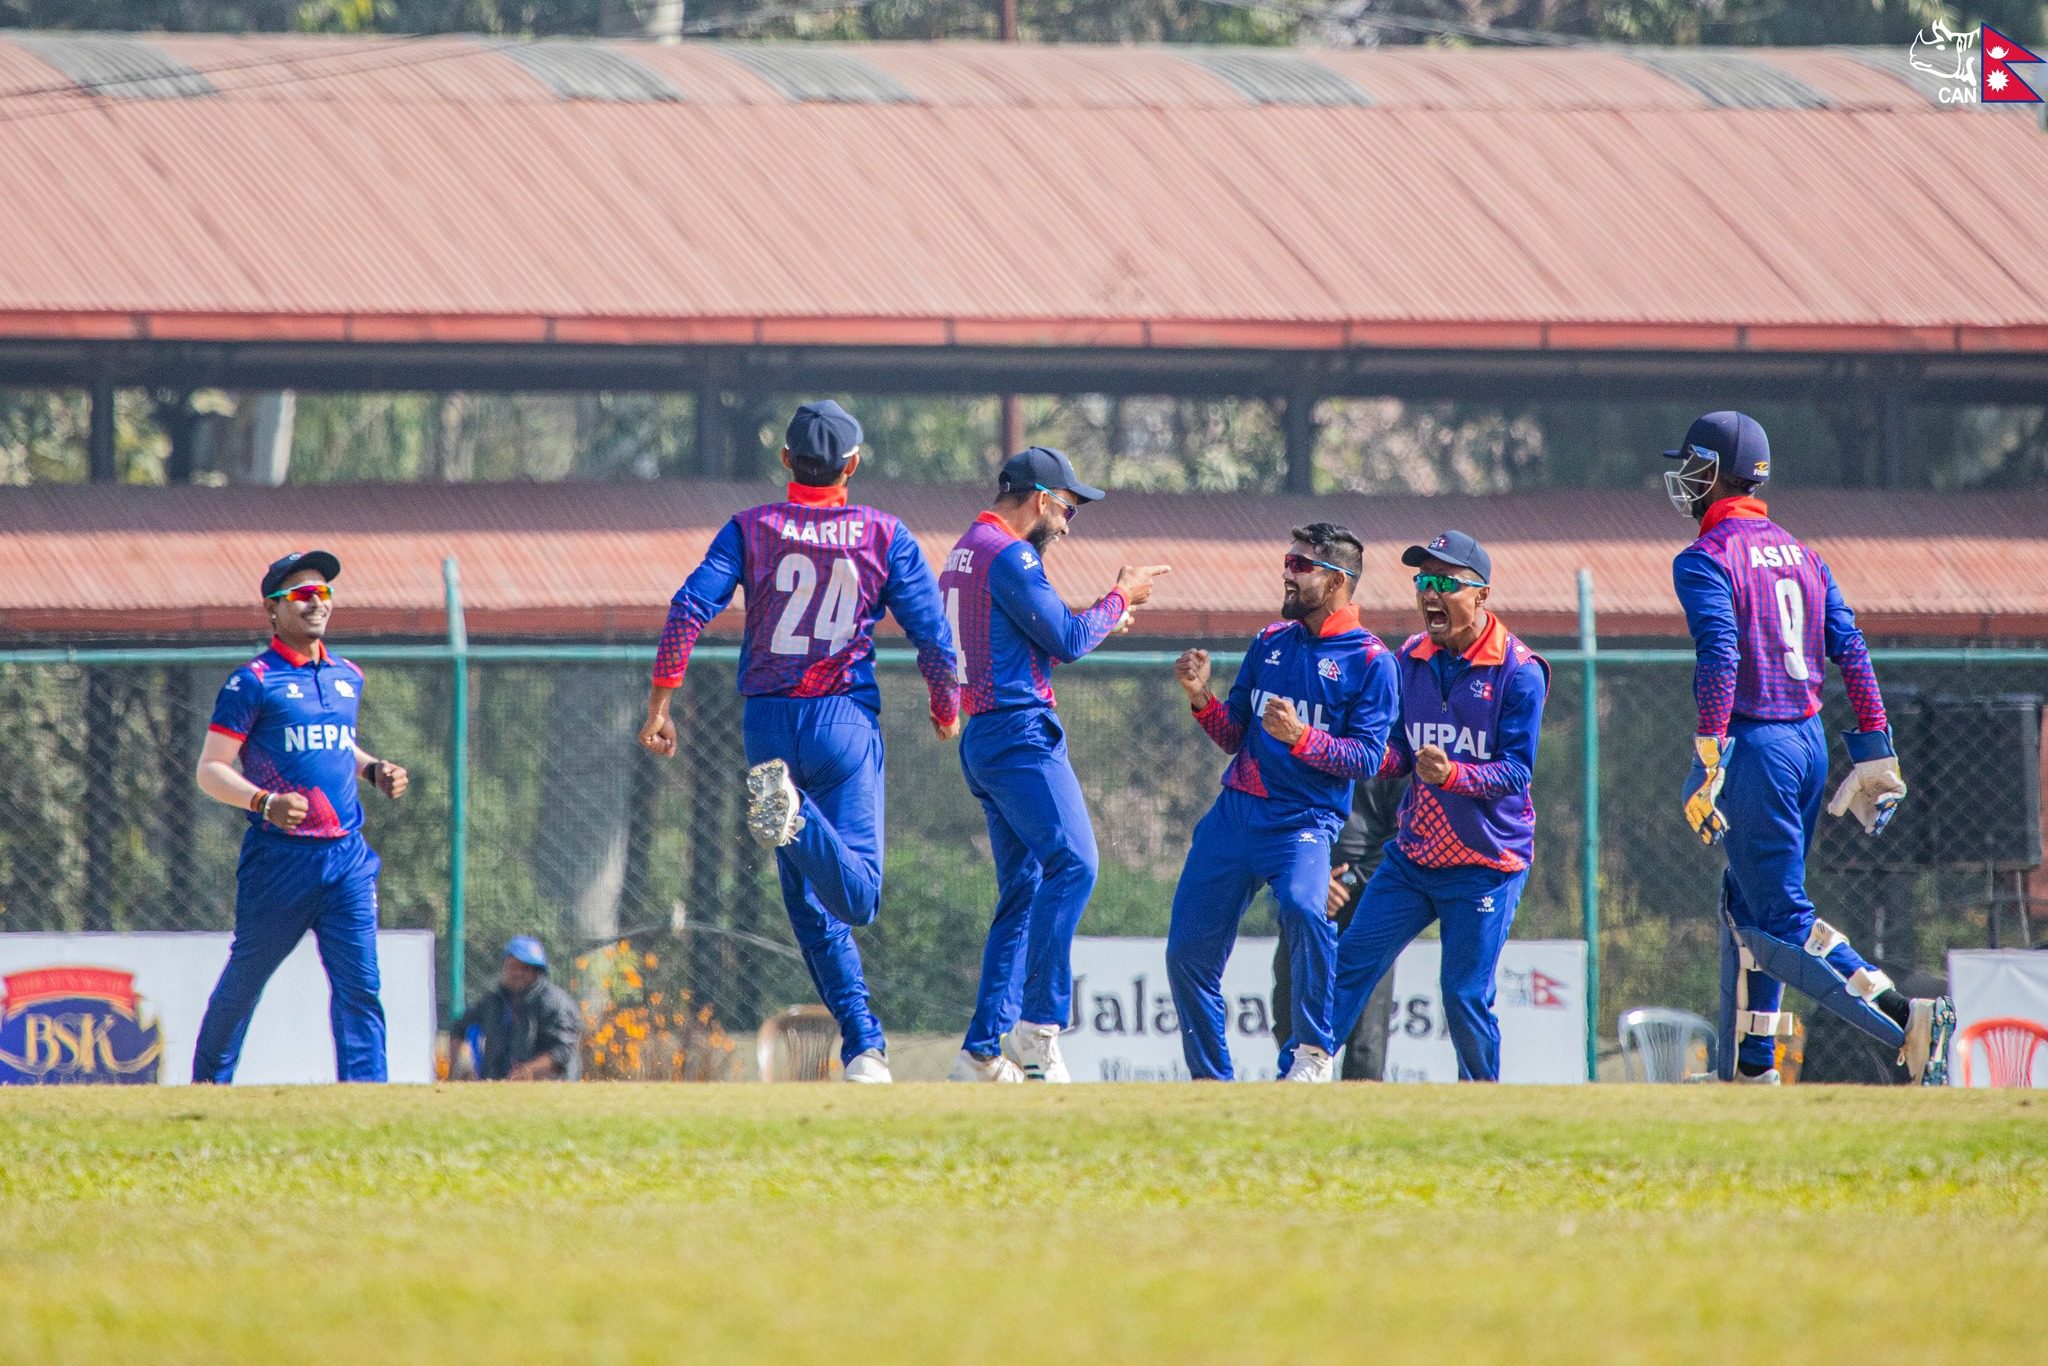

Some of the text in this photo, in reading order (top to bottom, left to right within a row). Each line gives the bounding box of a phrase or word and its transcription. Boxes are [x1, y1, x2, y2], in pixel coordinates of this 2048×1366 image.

[781, 519, 864, 546] AARIF
[1750, 544, 1803, 568] ASIF
[770, 553, 858, 657] 24
[1775, 579, 1809, 680] 9
[284, 724, 357, 752] NEPA
[1404, 722, 1492, 760] NEPAL
[25, 1012, 118, 1074] BSK
